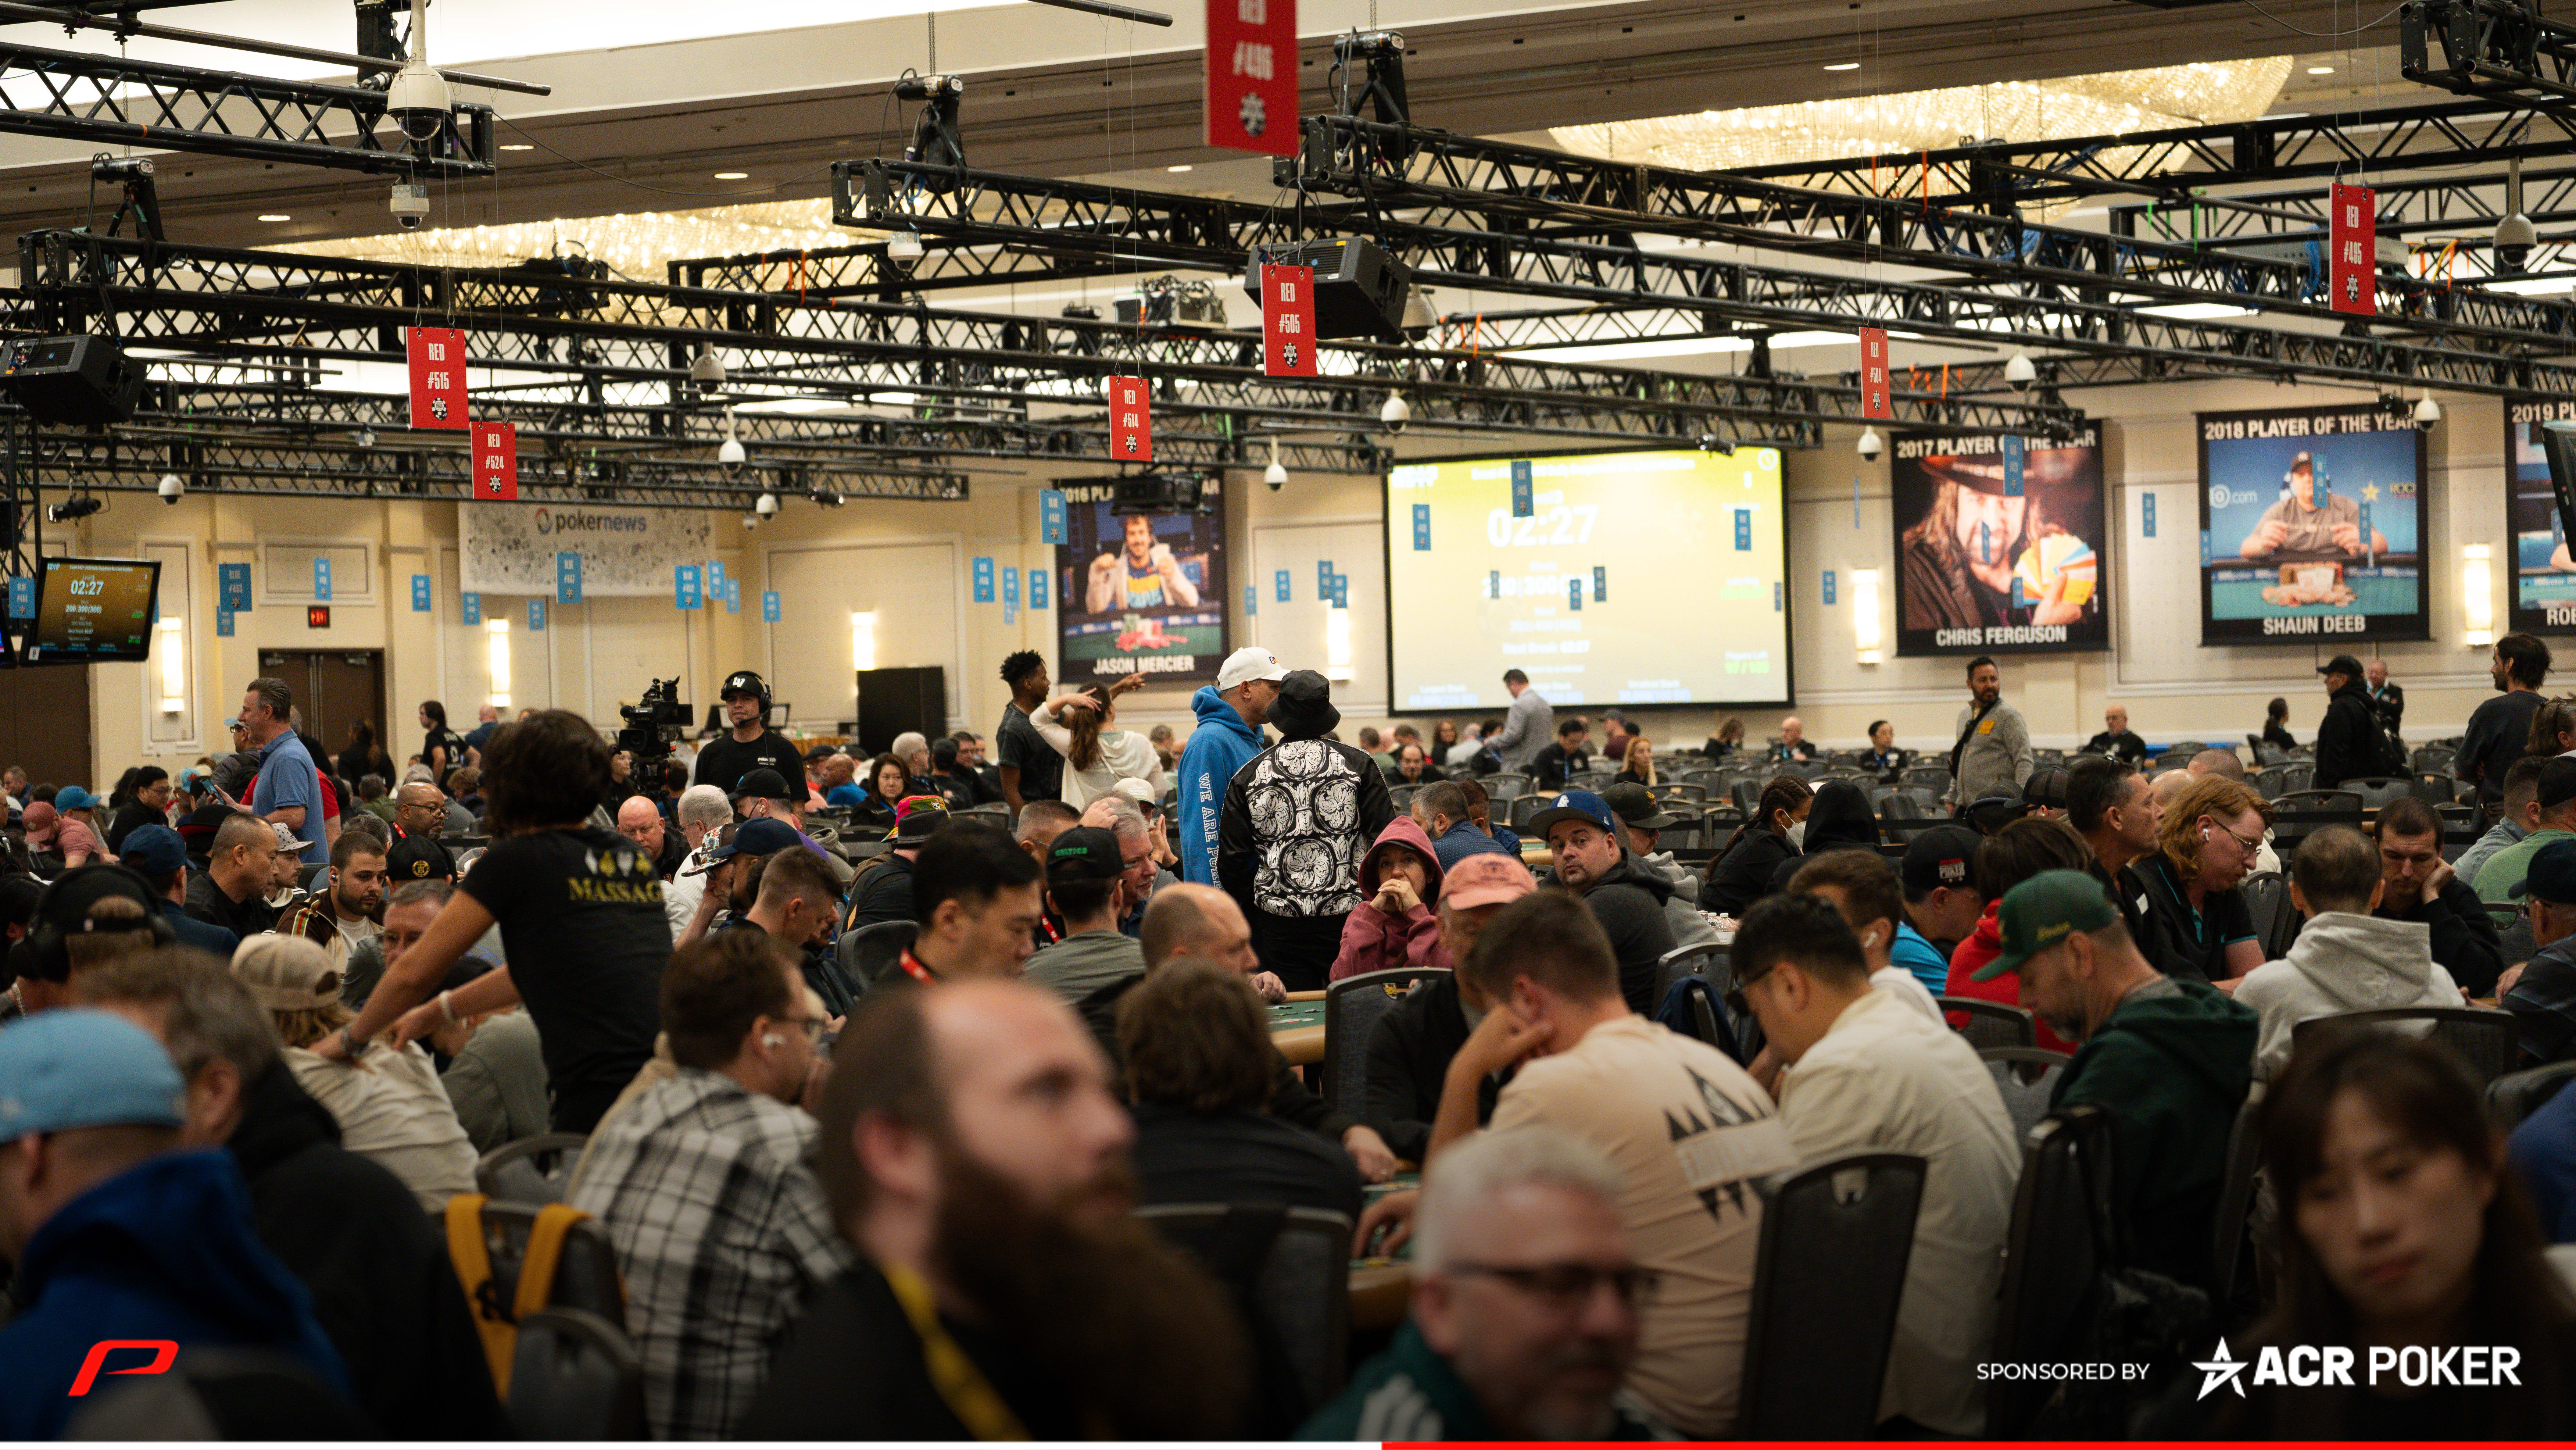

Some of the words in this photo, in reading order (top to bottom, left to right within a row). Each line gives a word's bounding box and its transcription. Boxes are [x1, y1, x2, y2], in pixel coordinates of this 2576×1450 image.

[2346, 204, 2359, 228] RED
[2343, 240, 2362, 265] #495
[1280, 282, 1295, 302] RED
[1279, 314, 1300, 334] #505
[428, 343, 445, 361] RED
[1870, 342, 1879, 358] RED
[427, 371, 450, 390] #515
[1870, 367, 1882, 383] #504
[1124, 389, 1136, 405] RED
[1123, 413, 1139, 428] #514
[2511, 403, 2554, 423] 2019
[2205, 421, 2243, 440] 2018
[2248, 418, 2310, 439] PLAYER
[2314, 416, 2336, 435] OF
[2339, 414, 2371, 434] THE
[487, 433, 500, 448] RED
[1896, 439, 1935, 458] 2017
[1937, 436, 1996, 456] PLAYER
[485, 455, 504, 469] #524
[556, 508, 647, 535] pokernews
[1487, 504, 1600, 548] 02:27
[71, 579, 104, 595] 02:27
[2263, 616, 2319, 635] SHAUN
[2323, 614, 2366, 633] DEEB
[1936, 628, 1982, 646] CHRIS
[1986, 625, 2067, 644] FERGUSON
[1094, 657, 1136, 675] JASON
[1138, 654, 1195, 673] MERCIER
[1199, 772, 1213, 802] WE
[1202, 807, 1219, 843] ARE
